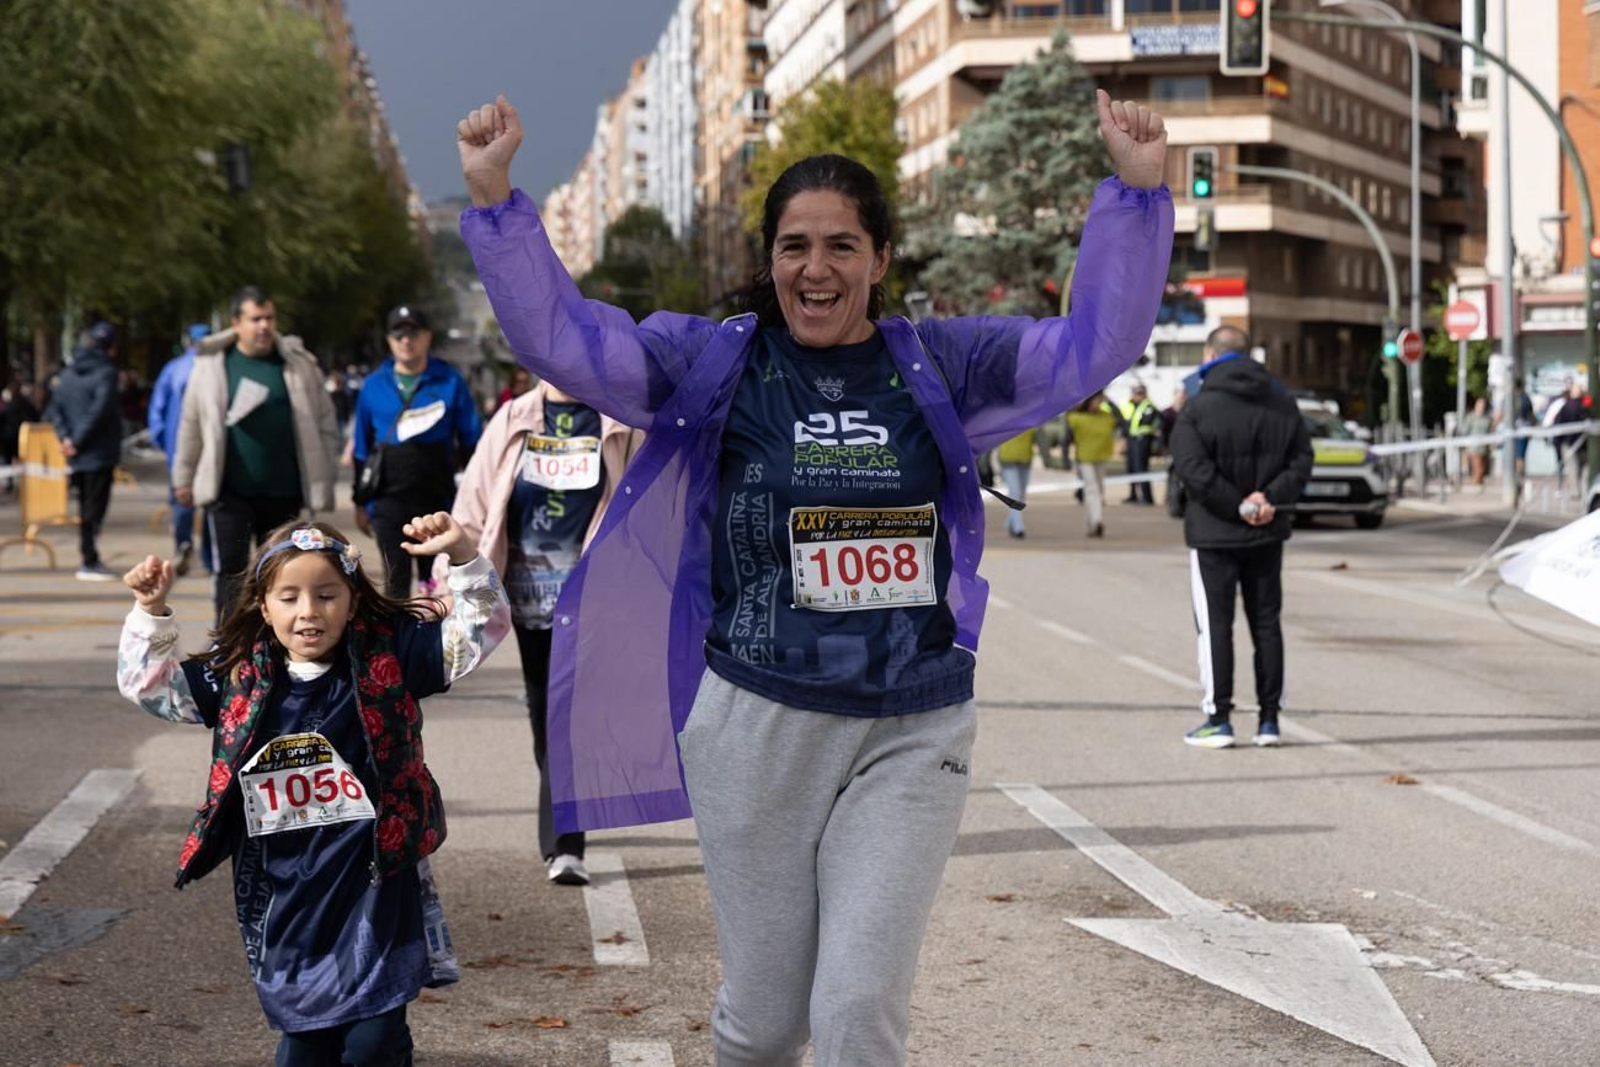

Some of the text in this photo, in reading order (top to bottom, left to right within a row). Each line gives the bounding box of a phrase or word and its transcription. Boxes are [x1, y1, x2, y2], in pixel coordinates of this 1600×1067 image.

[794, 410, 889, 446] 25
[532, 456, 589, 476] 1054
[793, 466, 901, 477] y gran caminata
[794, 454, 899, 469] POPULAR
[743, 463, 763, 483] IES
[791, 475, 805, 487] Por
[808, 476, 816, 487] la
[819, 477, 833, 488] Paz
[843, 478, 850, 488] la
[796, 513, 827, 530] XXV
[829, 511, 931, 520] CARRERA POPULAR
[829, 518, 931, 529] y gran caminata
[732, 491, 758, 638] SANTA CATALINA
[747, 493, 777, 638] DE ALEJANDRÍA
[810, 543, 919, 587] 1068
[274, 751, 281, 761] y
[287, 746, 313, 758] gran
[259, 768, 362, 811] 1056
[246, 936, 261, 960] DE
